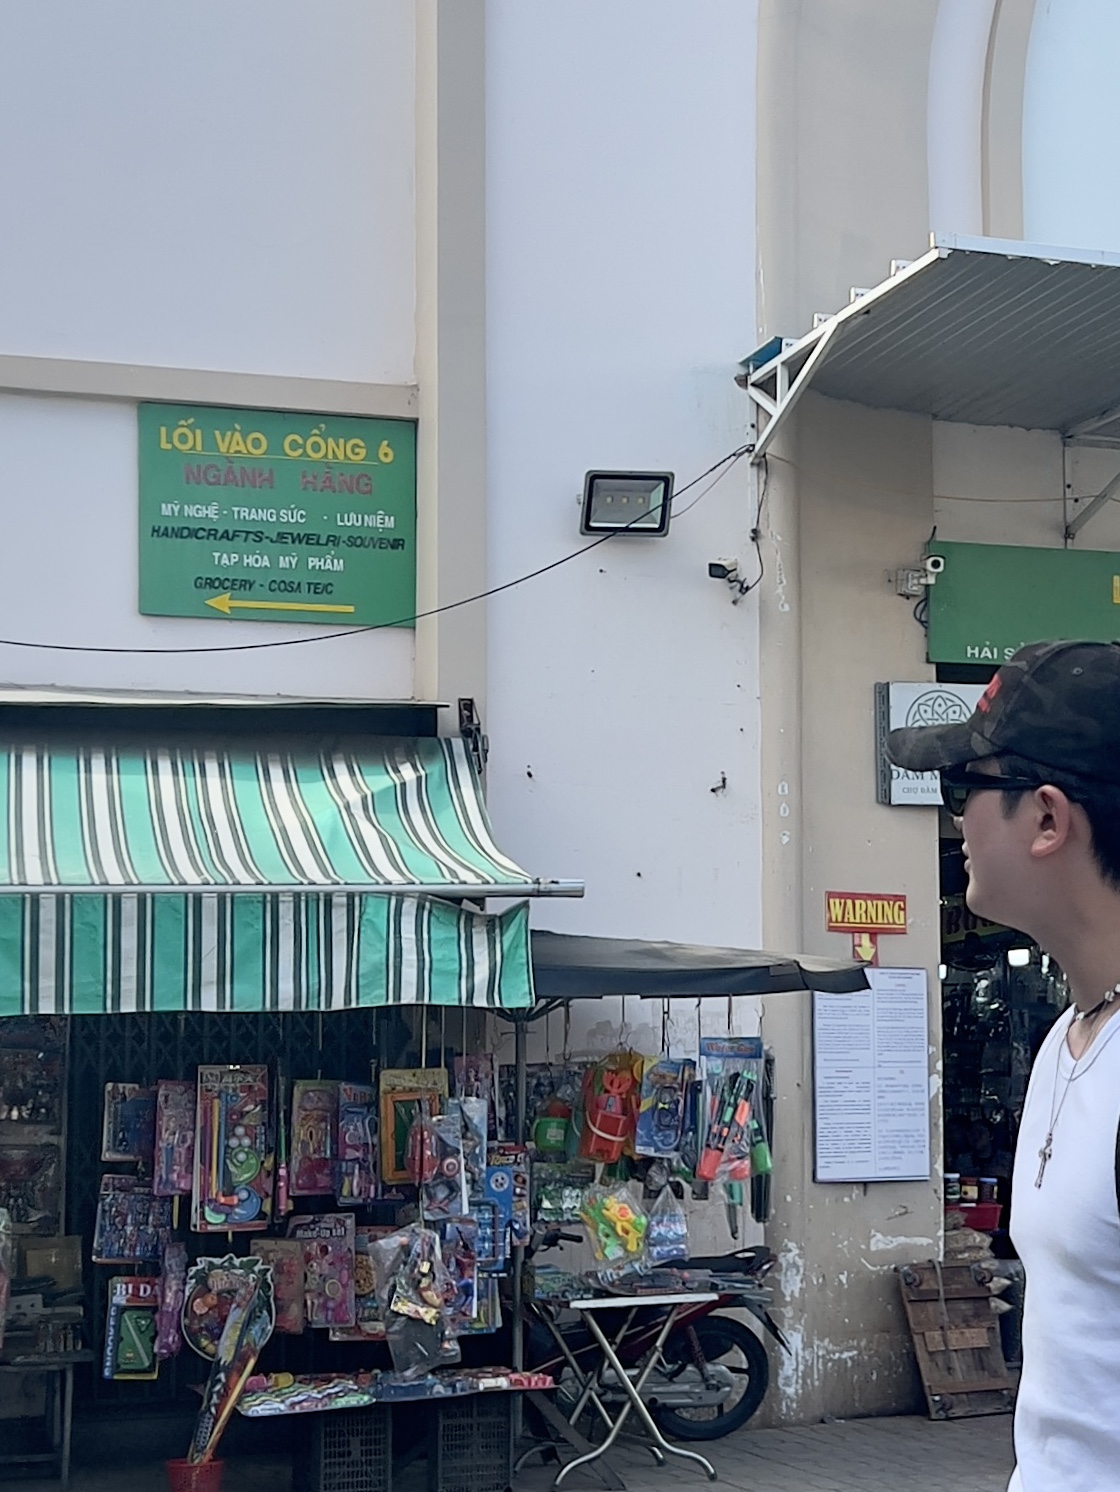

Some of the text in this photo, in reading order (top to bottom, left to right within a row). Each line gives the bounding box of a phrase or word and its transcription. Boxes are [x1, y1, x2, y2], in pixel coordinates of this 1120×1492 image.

[159, 418, 394, 463] LỐI VÀO CỔNG 6
[184, 459, 274, 489] NGÀNH
[184, 502, 219, 521] NGHỆ
[232, 507, 276, 522] TRANG
[280, 504, 306, 522] SỨC
[337, 511, 361, 526] LƯU
[364, 510, 394, 532] NIỆM
[212, 552, 239, 568] TẠP
[243, 550, 270, 568] HÓA
[308, 550, 344, 571] PHẨM
[194, 576, 256, 591] GROCERY
[967, 641, 998, 660] HẢI
[828, 897, 905, 925] WARNING
